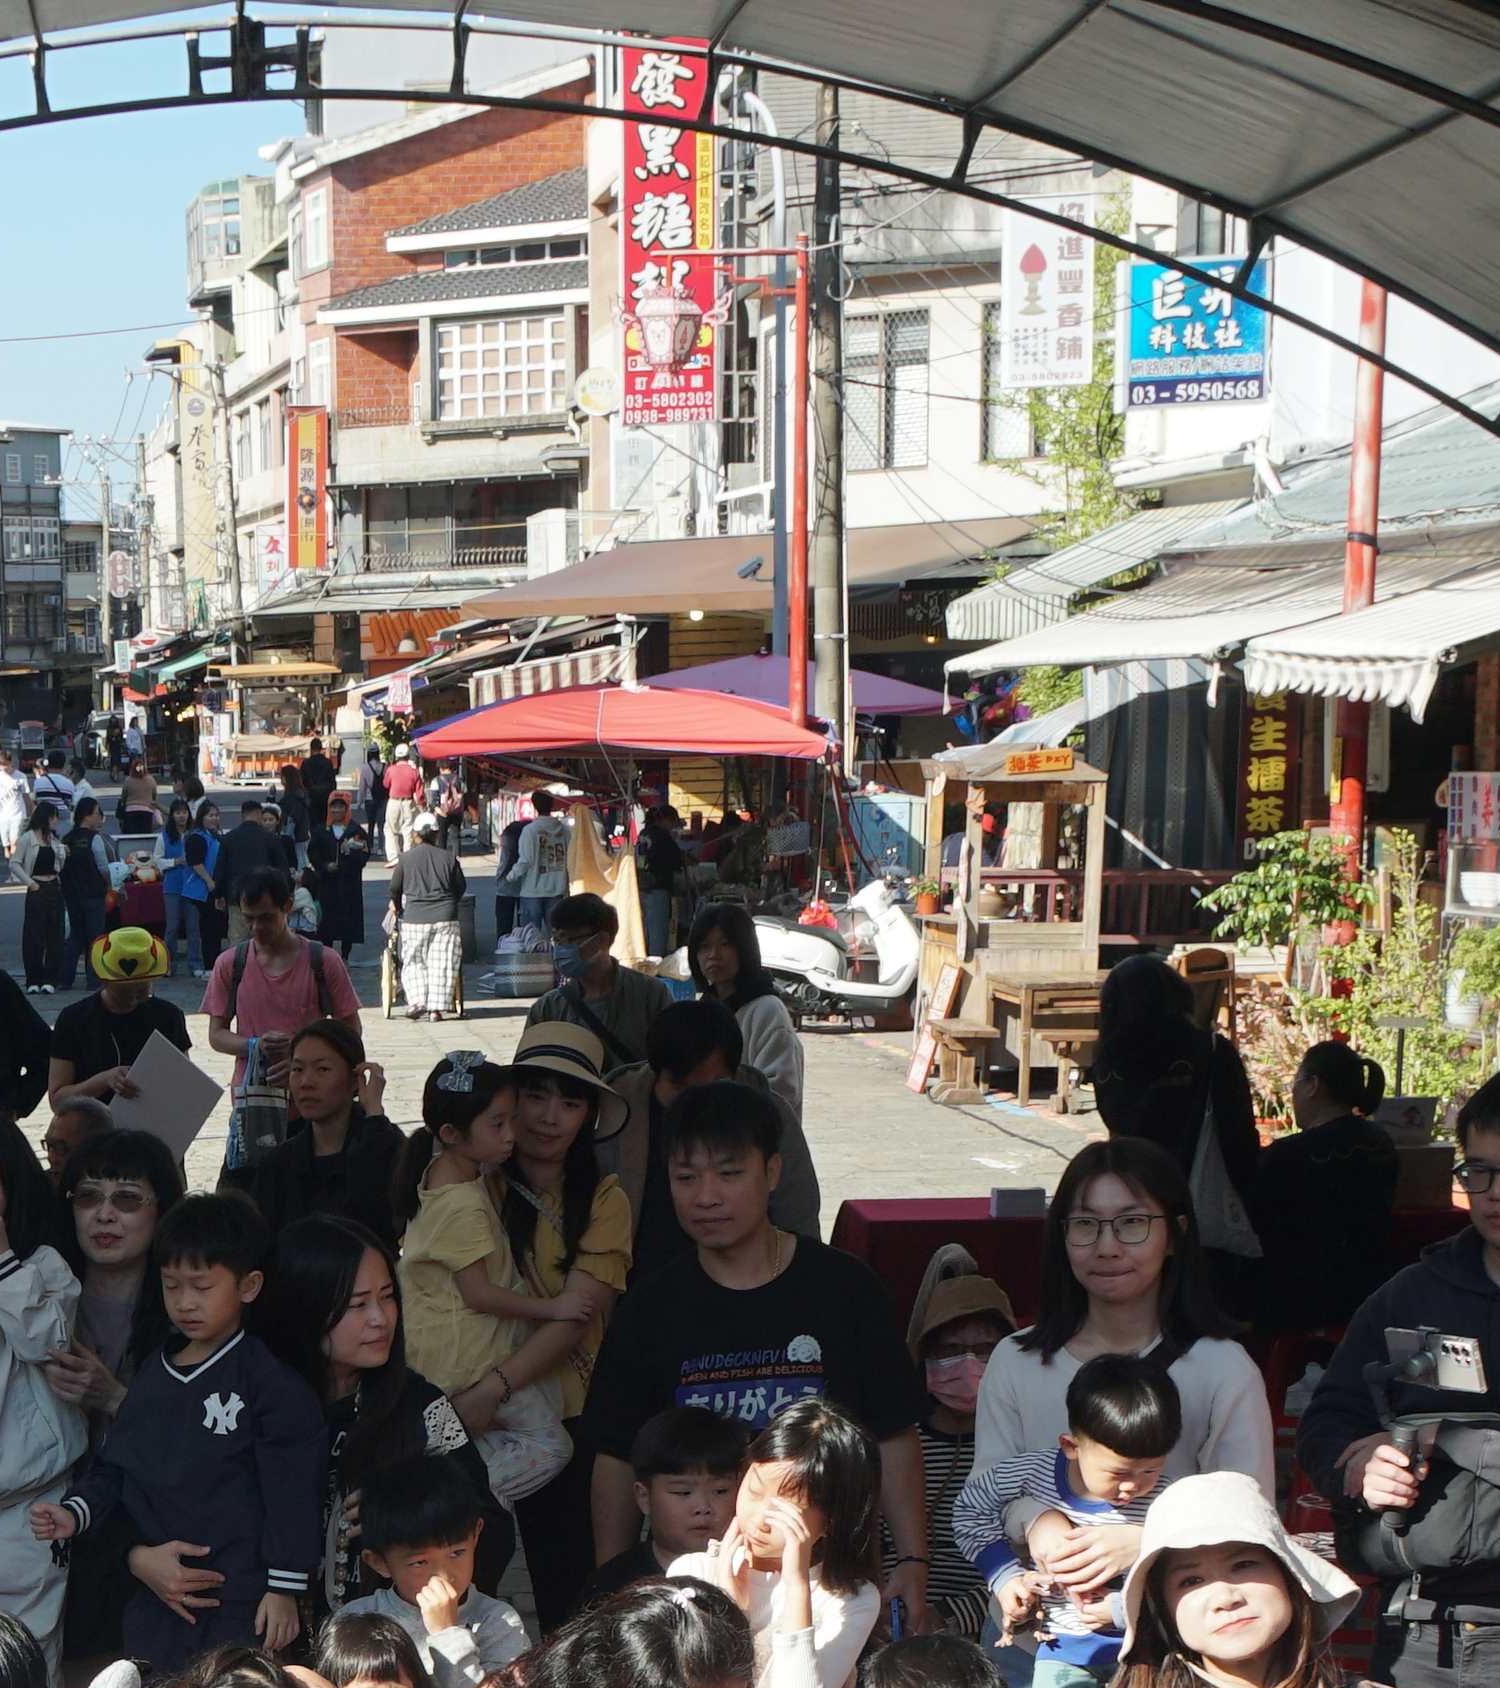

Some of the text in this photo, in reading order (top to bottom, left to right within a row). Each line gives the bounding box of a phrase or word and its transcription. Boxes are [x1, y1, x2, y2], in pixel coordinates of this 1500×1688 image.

[1150, 320, 1244, 354] 科技社
[626, 392, 713, 408] 03-5802302
[626, 409, 713, 424] 0938-989731
[202, 1392, 246, 1435] NY
